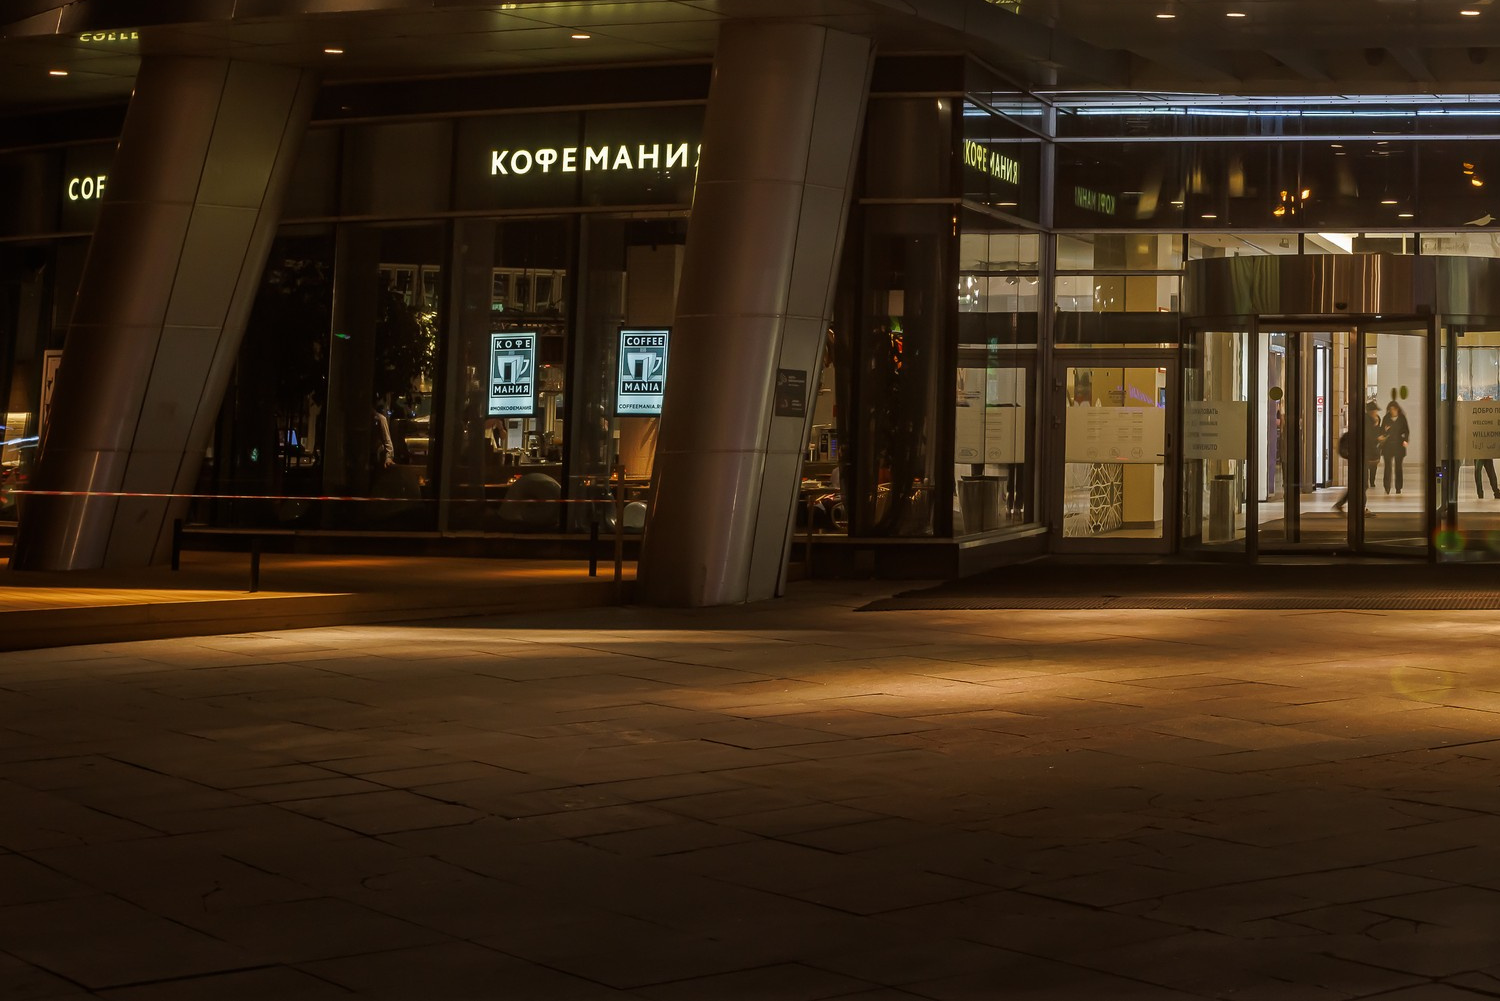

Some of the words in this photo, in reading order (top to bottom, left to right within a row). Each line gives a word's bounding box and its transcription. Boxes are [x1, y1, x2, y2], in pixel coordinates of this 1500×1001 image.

[491, 143, 701, 175] КОФЕМАНИ
[69, 176, 106, 200] COF
[495, 339, 531, 349] КОФЕ
[626, 337, 664, 346] COFFEE
[493, 385, 529, 394] МАНИЯ
[624, 382, 660, 391] MANIA
